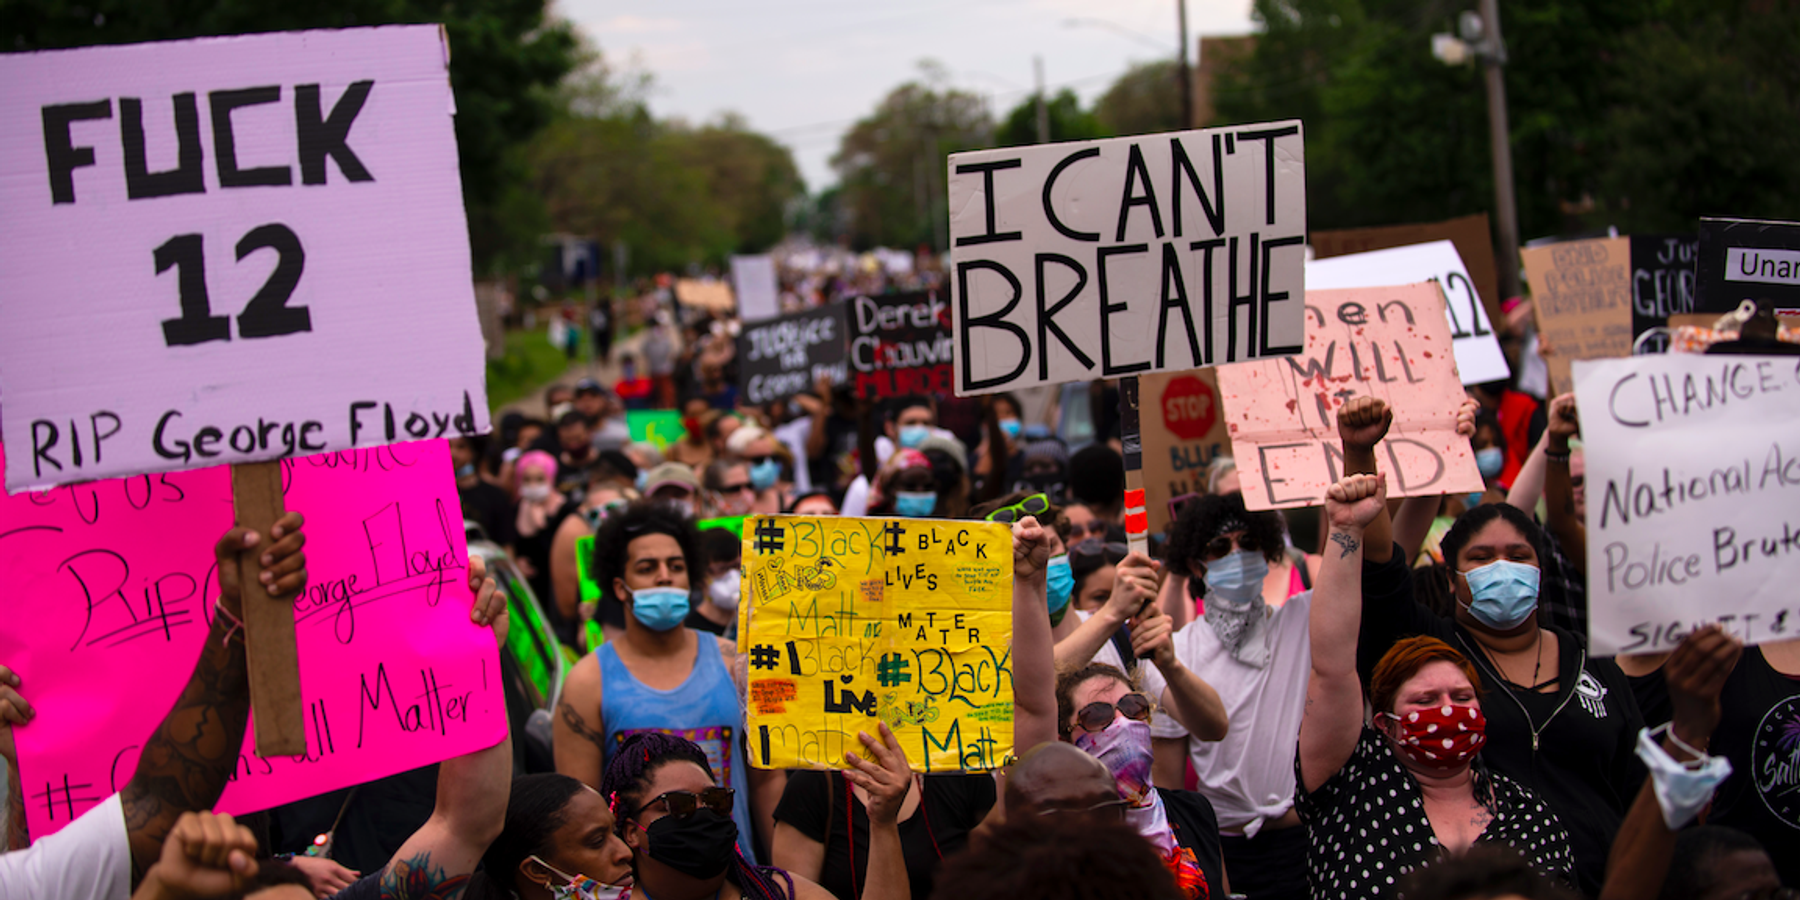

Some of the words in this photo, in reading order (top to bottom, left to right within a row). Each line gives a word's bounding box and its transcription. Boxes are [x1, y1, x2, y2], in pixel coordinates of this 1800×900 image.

[42, 80, 375, 206] FUCK
[956, 158, 1022, 247] I
[1042, 125, 1298, 243] CAN'T
[153, 223, 312, 347] 12
[956, 232, 1304, 391] BREATHE
[855, 290, 948, 334] Derek
[1304, 300, 1416, 328] en
[856, 363, 954, 399] MURDE
[1285, 340, 1426, 385] WILL
[31, 411, 121, 478] RIP
[153, 410, 325, 463] George
[350, 389, 478, 448] Floyd
[1166, 393, 1211, 421] STOP
[1600, 459, 1750, 529] National
[362, 498, 466, 608] Floyd
[885, 564, 938, 591] LIVES
[1604, 541, 1701, 594] Police
[1620, 620, 1710, 651] SIG
